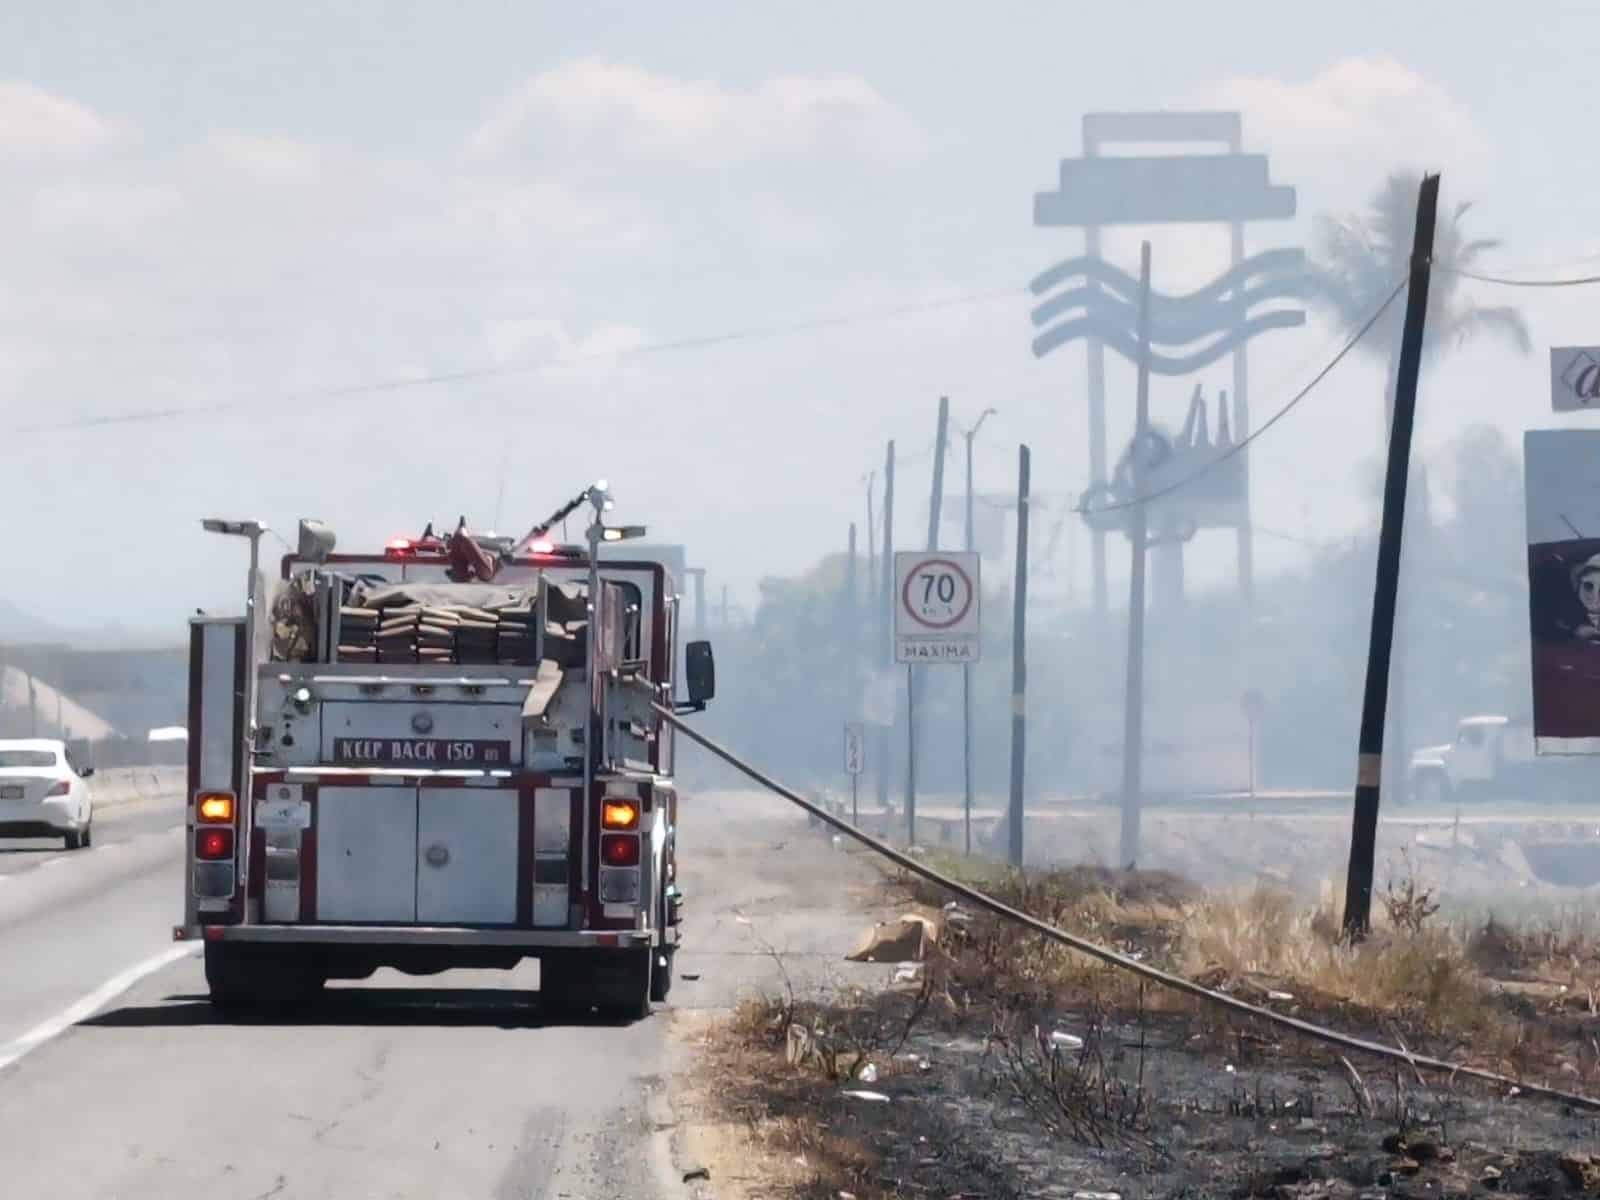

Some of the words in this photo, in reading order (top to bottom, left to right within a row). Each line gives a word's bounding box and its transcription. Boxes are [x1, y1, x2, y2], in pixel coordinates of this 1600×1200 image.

[920, 574, 955, 604] 70
[904, 644, 970, 657] MAXIMA
[343, 740, 382, 758] KEEP
[391, 741, 436, 760] BACK
[447, 743, 474, 761] 150
